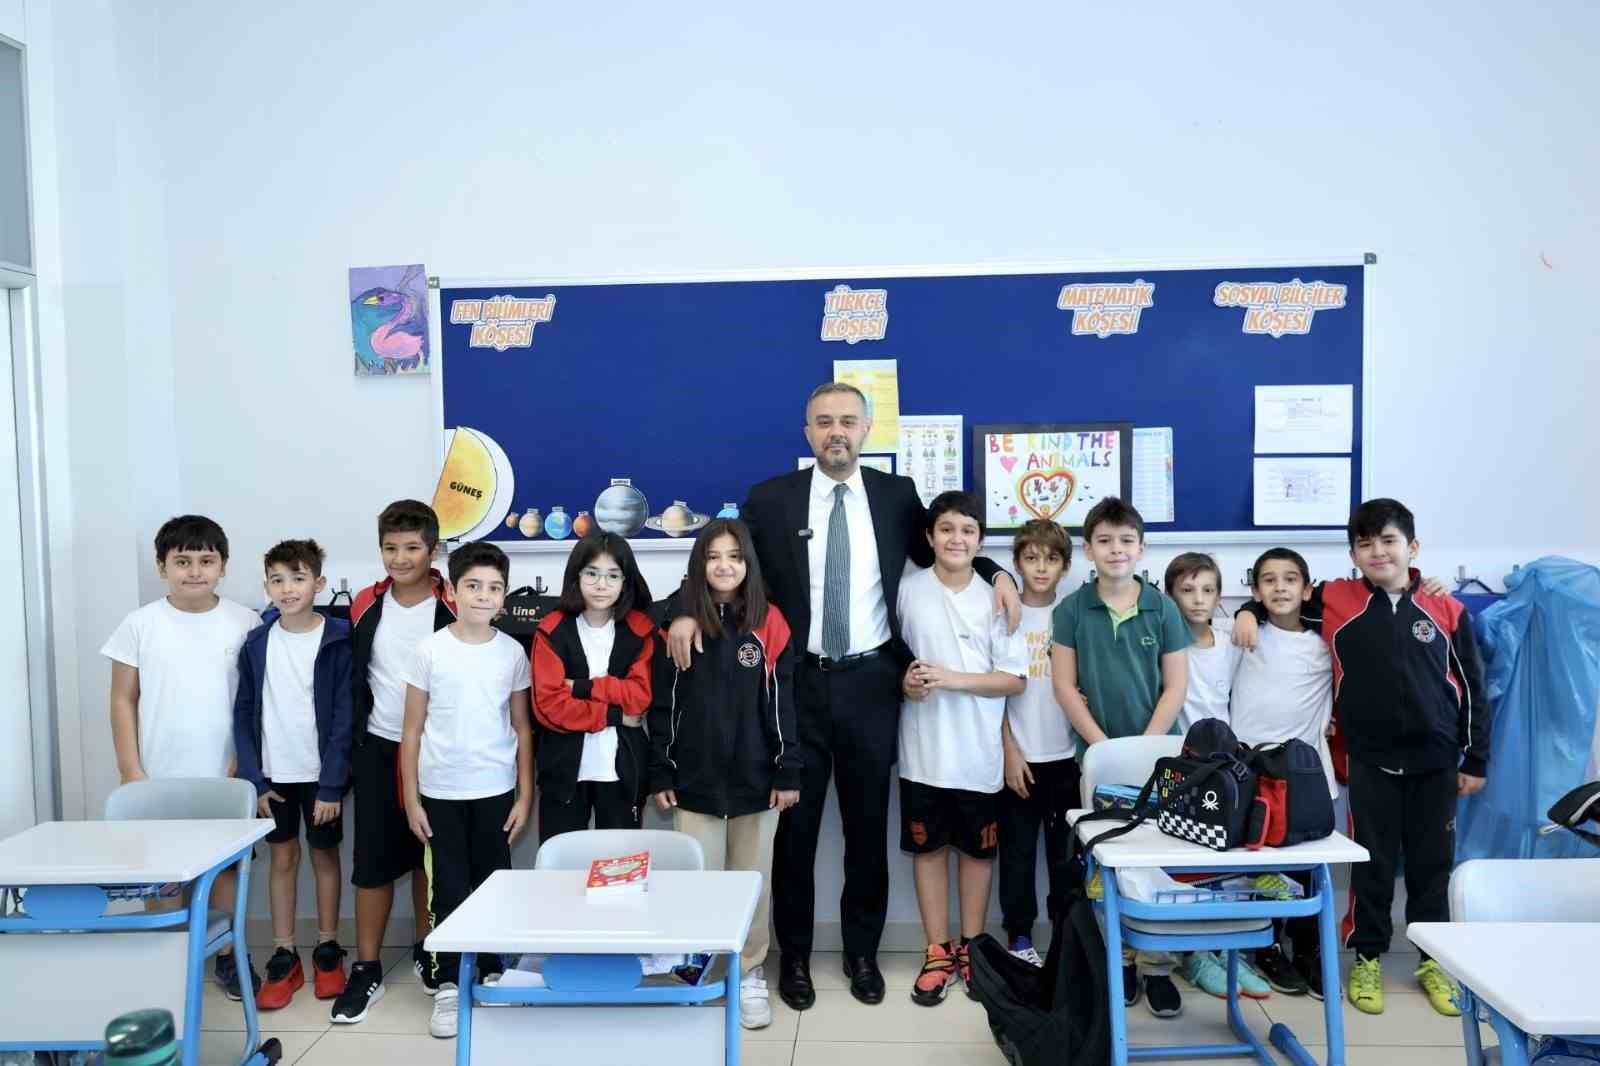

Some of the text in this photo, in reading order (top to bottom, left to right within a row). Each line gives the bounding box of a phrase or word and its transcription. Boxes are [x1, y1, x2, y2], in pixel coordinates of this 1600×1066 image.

[989, 431, 1115, 453] BE KIND THE
[1026, 451, 1112, 471] ANIMALS
[449, 481, 483, 500] GÜNEŞ
